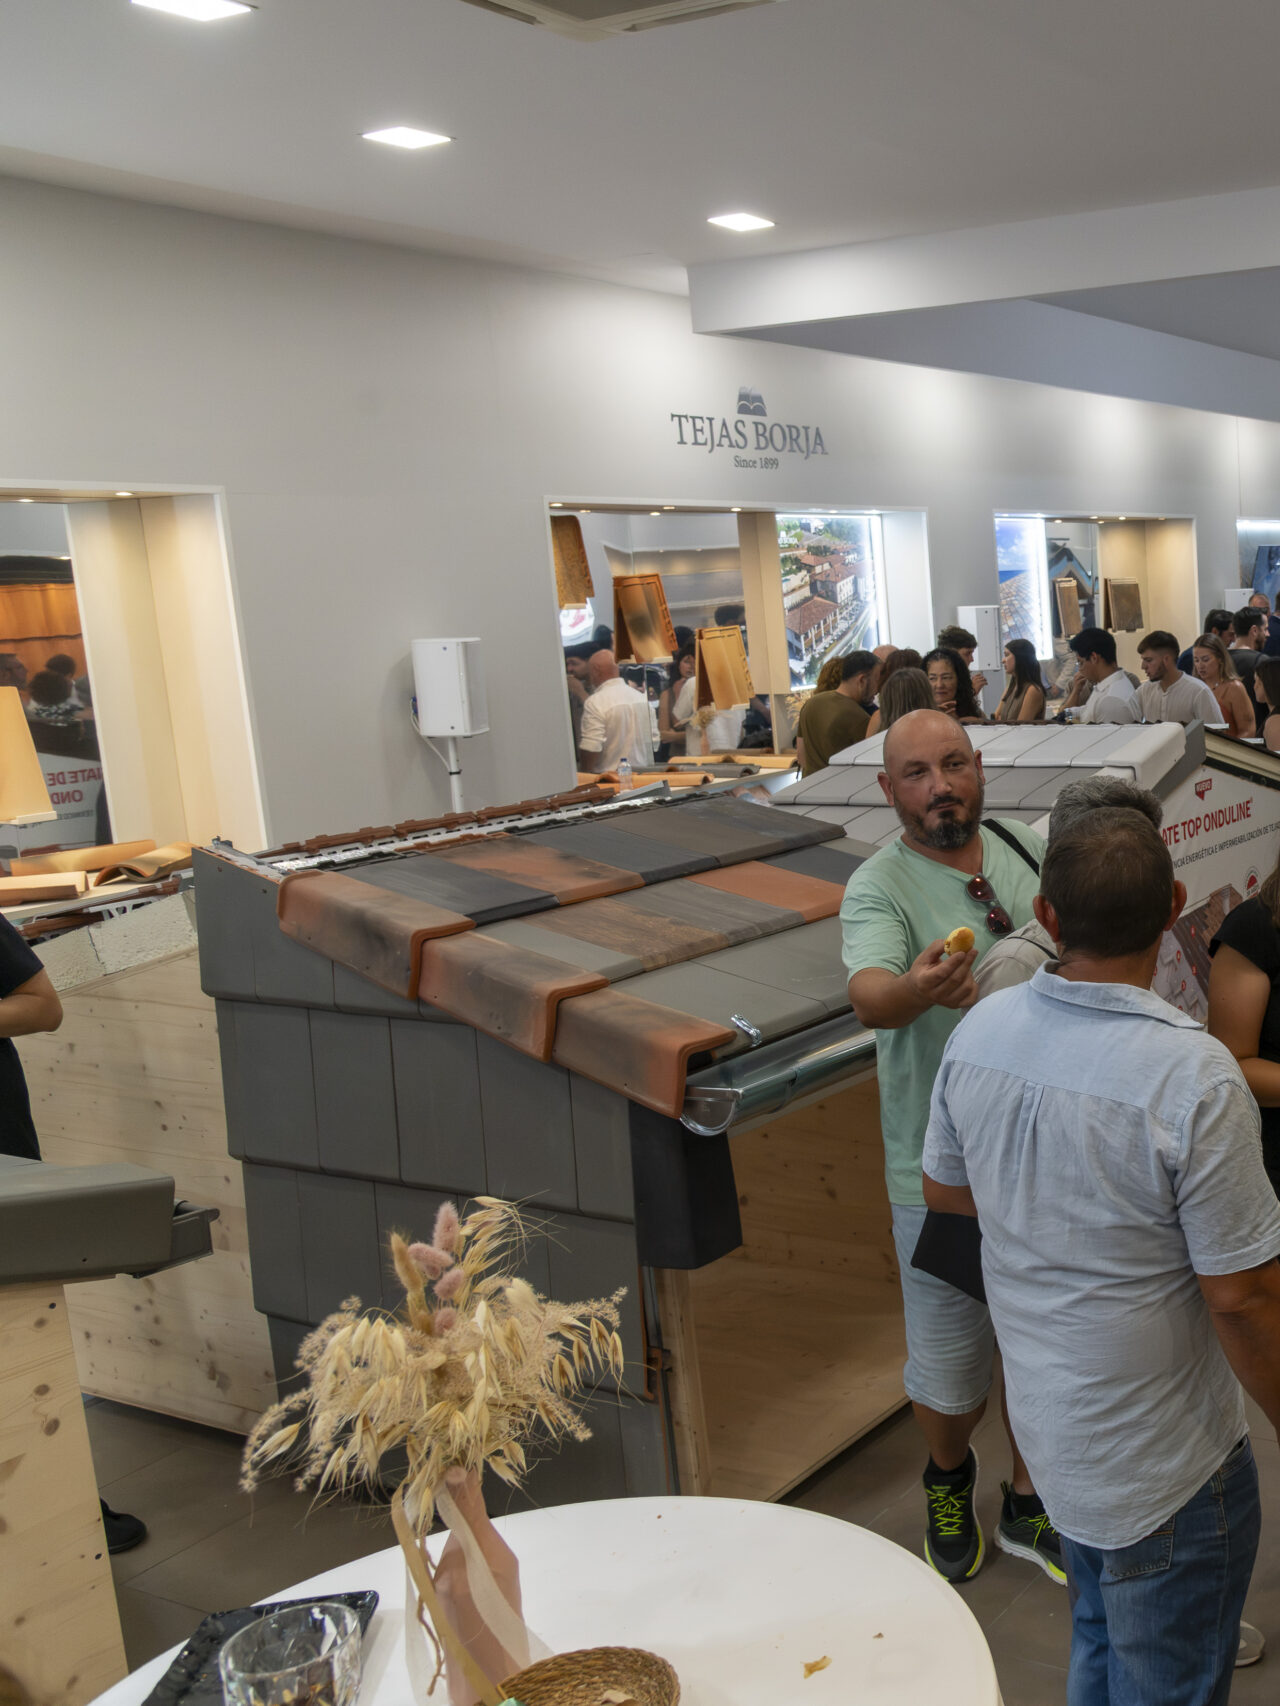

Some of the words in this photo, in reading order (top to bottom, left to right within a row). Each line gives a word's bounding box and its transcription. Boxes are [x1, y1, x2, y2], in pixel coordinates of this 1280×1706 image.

[670, 413, 748, 453] TEJAS
[752, 421, 829, 460] BORJA
[734, 455, 757, 469] Since
[759, 457, 779, 470] 1899
[1181, 816, 1202, 839] TOP
[1186, 847, 1215, 865] ENERGÉTICA
